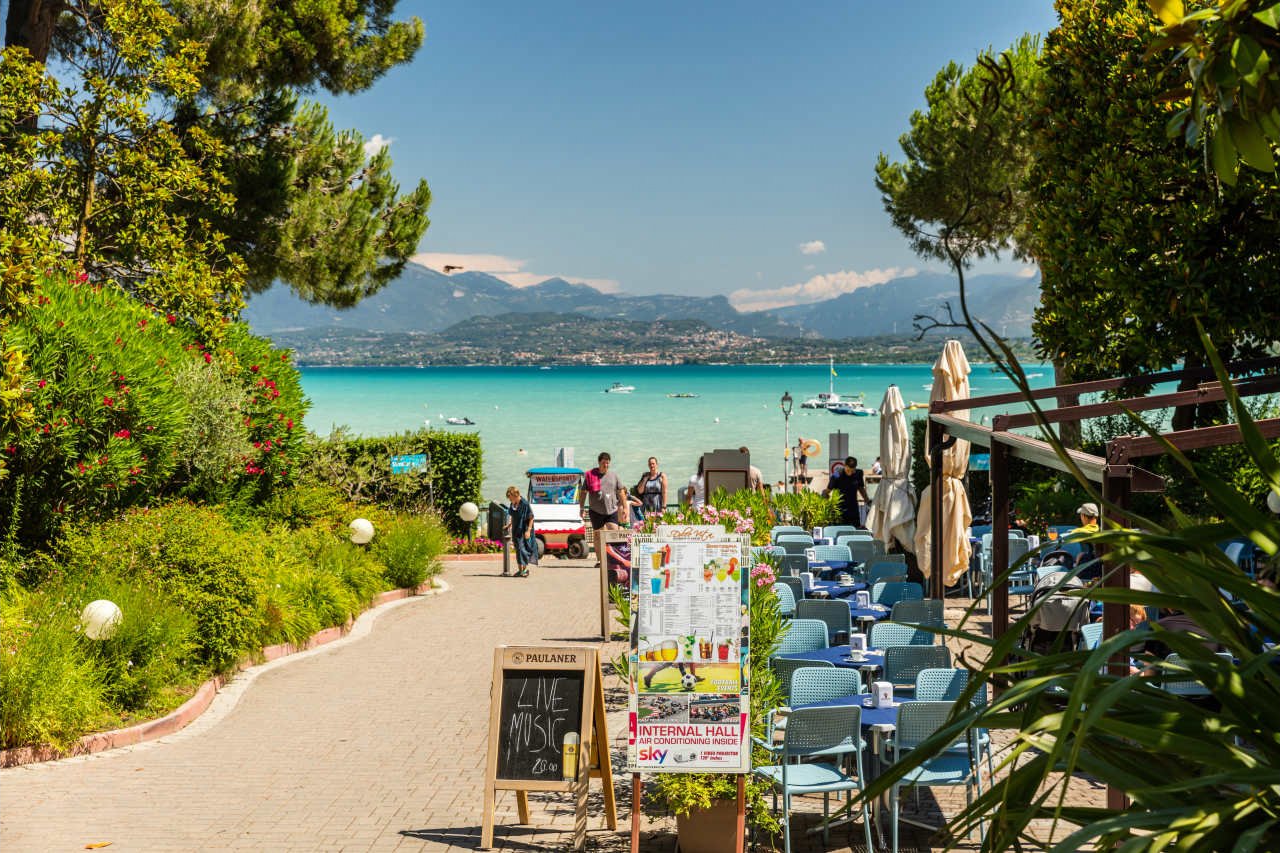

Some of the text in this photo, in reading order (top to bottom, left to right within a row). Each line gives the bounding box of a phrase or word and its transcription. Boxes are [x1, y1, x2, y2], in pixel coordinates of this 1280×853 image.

[526, 654, 576, 663] PAULANER
[517, 678, 569, 712] LIVE
[639, 726, 738, 736] INTERNAL HALL
[639, 746, 668, 764] sky
